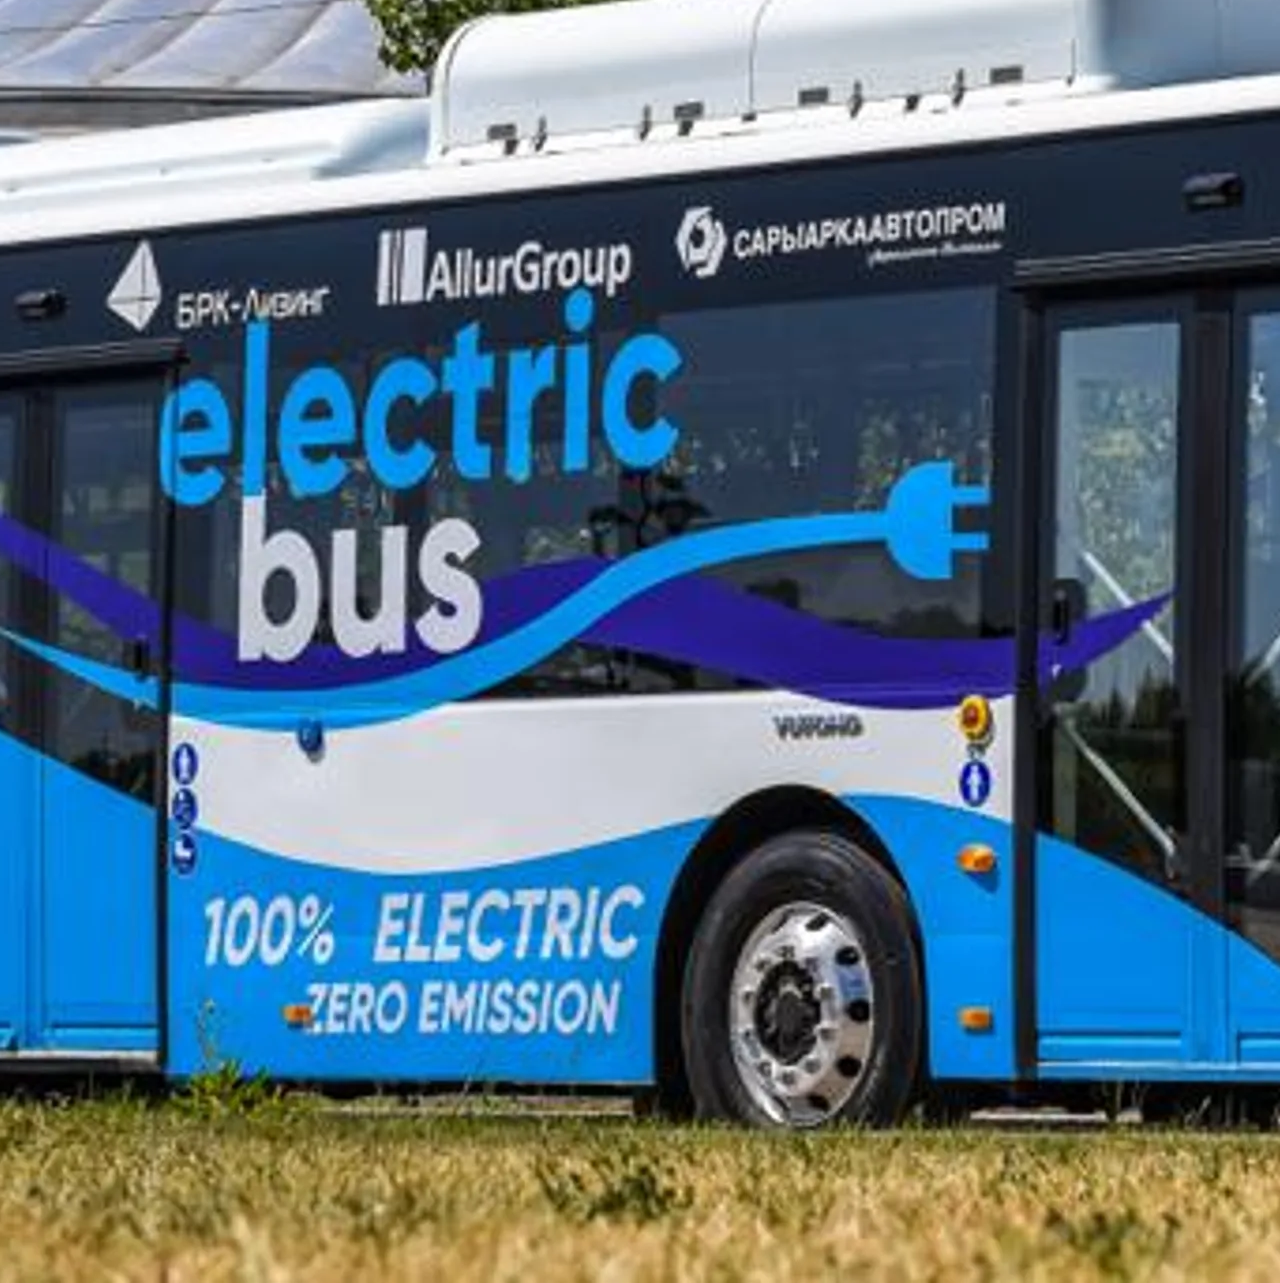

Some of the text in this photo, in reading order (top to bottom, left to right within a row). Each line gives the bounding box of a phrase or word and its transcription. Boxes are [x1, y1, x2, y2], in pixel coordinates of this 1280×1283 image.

[732, 202, 1006, 259] САРЫАРКААВТОПРОМ
[425, 240, 632, 303] AllurGroup
[159, 289, 682, 506] electric
[237, 494, 481, 663] bus
[204, 884, 646, 966] 100% ELECTRIC
[306, 979, 619, 1035] ZERO EMISSION
